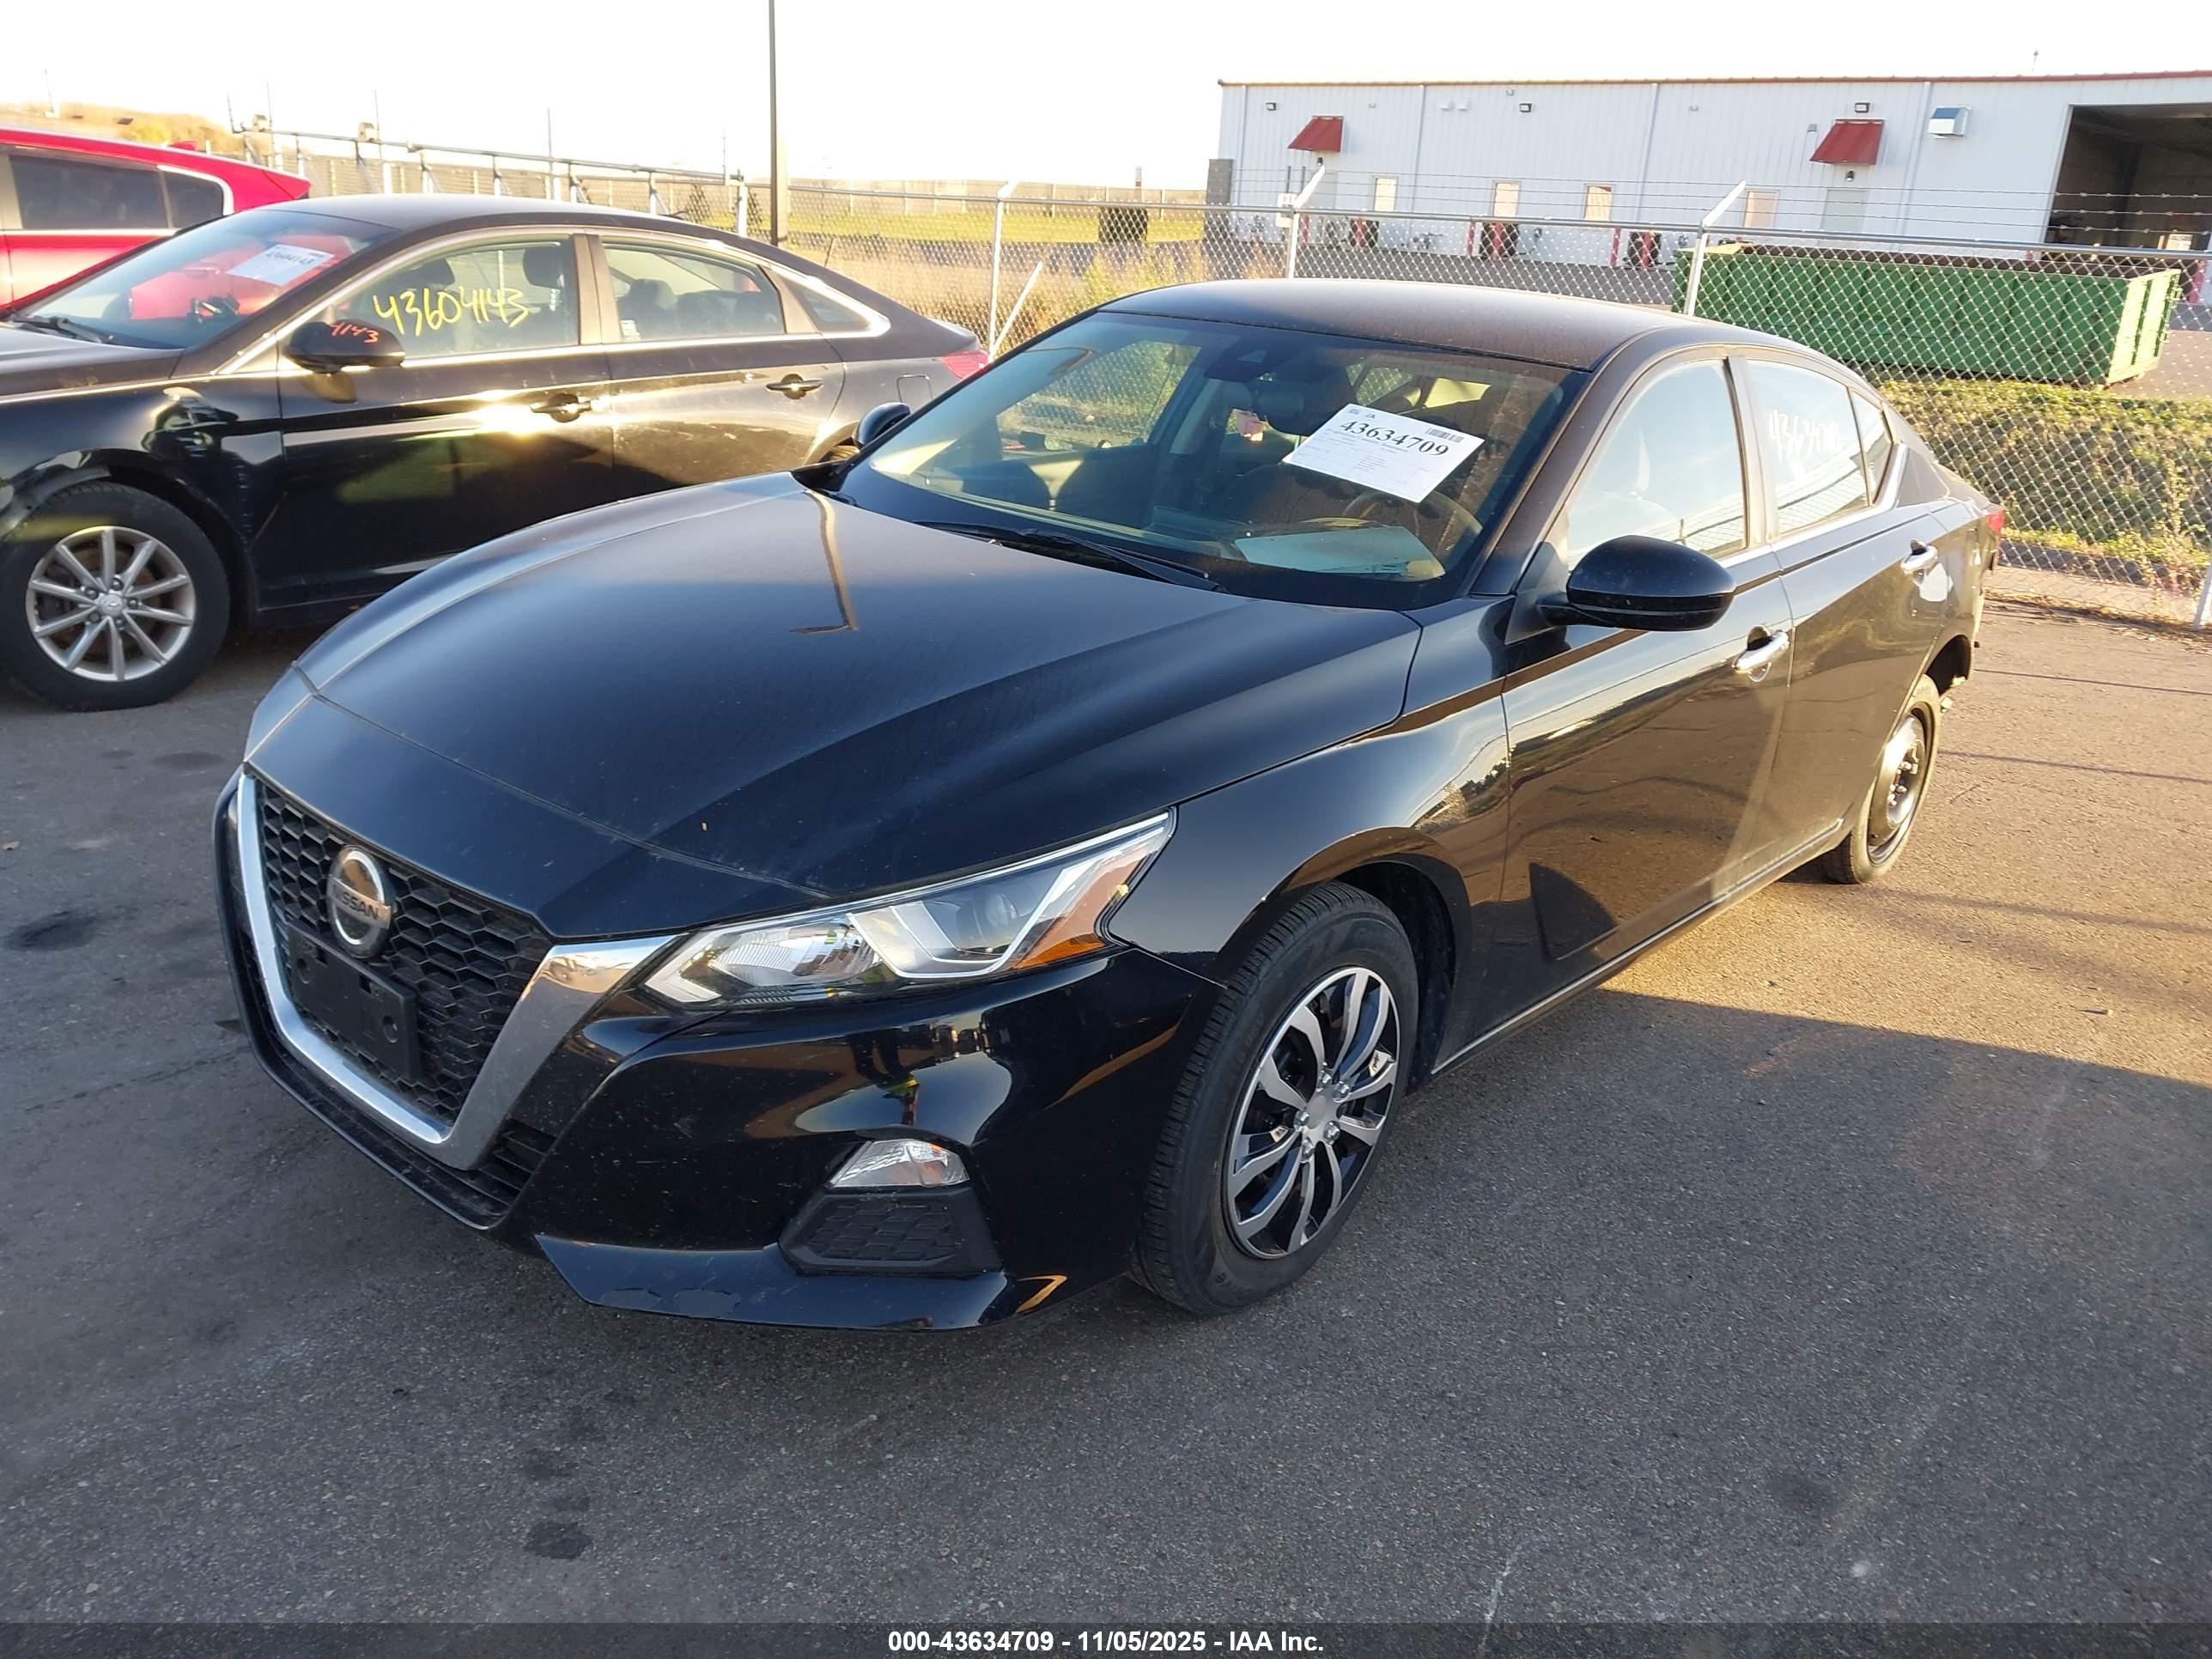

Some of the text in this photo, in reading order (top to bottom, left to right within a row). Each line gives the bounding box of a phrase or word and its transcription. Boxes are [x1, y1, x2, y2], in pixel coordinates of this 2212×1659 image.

[373, 286, 529, 337] 43604143
[330, 322, 379, 343] 4143
[1340, 420, 1449, 456] 43634709
